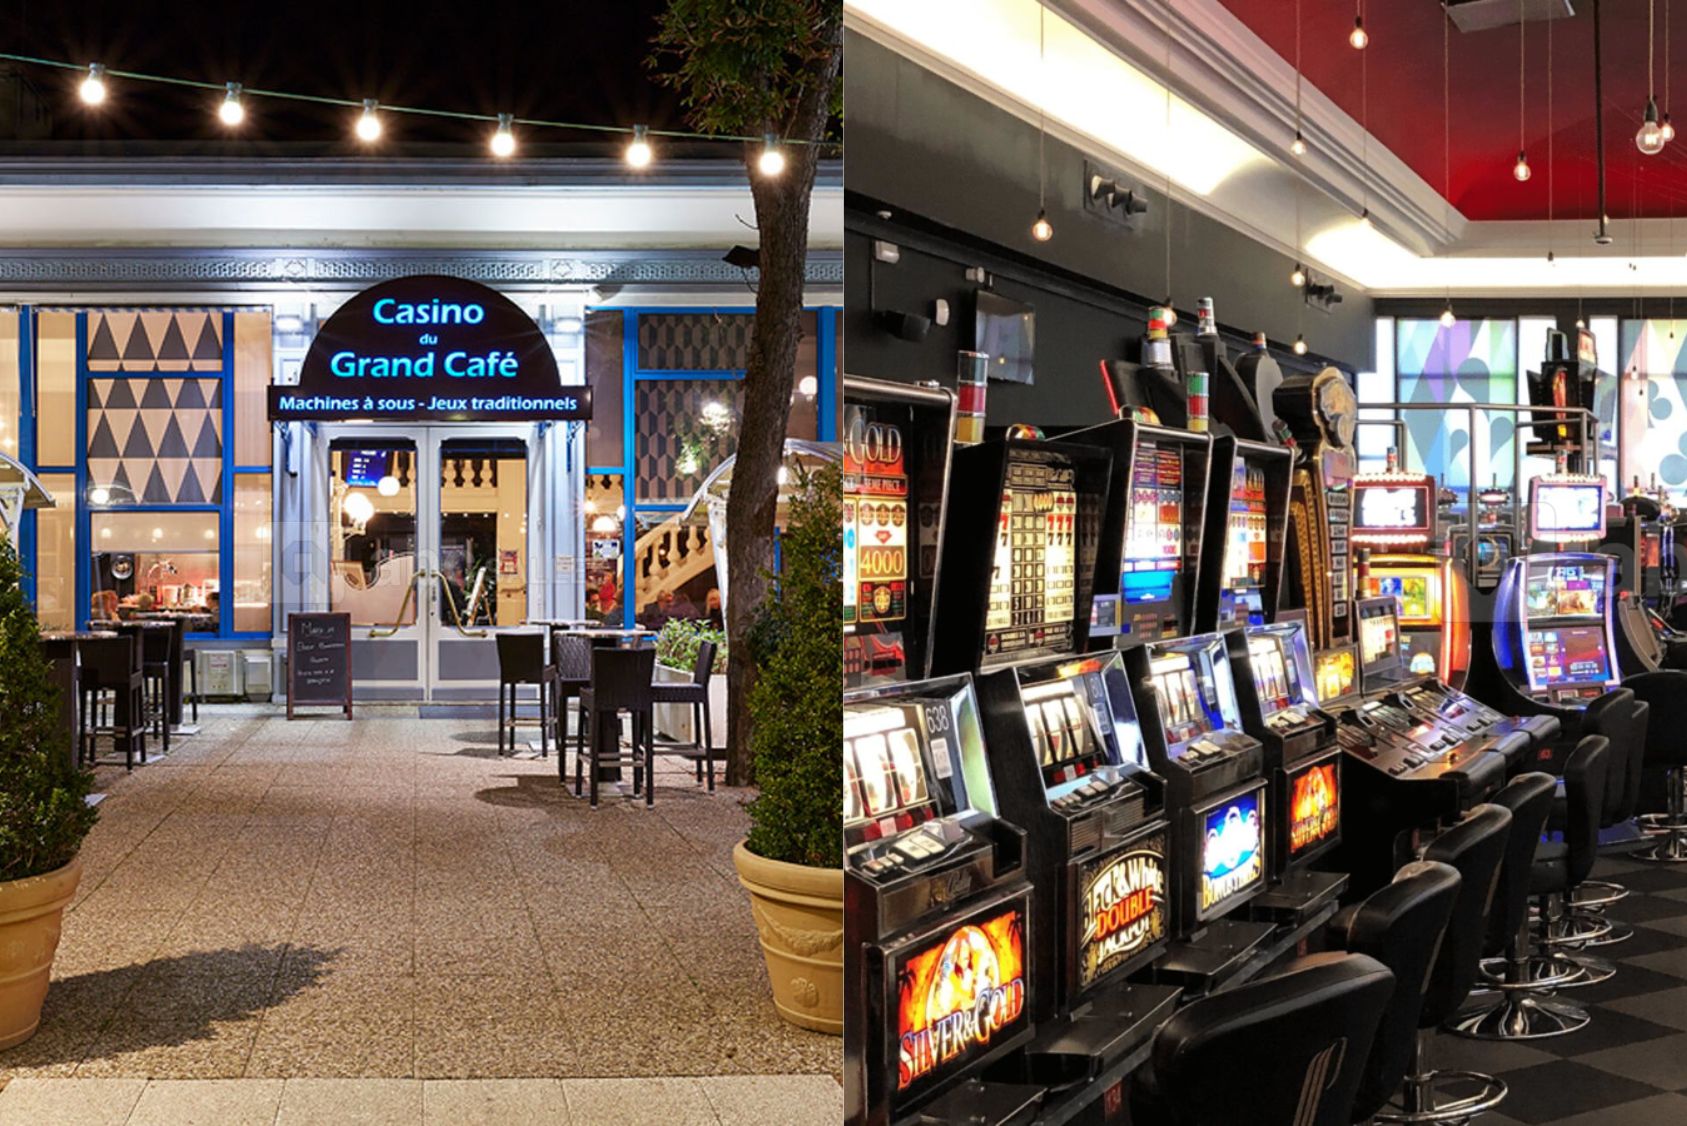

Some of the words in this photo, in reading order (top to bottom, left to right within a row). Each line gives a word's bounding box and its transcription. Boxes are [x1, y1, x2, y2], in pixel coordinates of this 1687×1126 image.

[373, 299, 484, 324] Casino
[419, 334, 438, 346] du
[331, 352, 434, 378] Grand
[444, 351, 519, 378] Café
[279, 396, 359, 411] Machines
[363, 396, 374, 411] à
[377, 399, 416, 411] sous
[427, 396, 468, 411] Jeux
[471, 396, 577, 411] traditionnels
[859, 549, 903, 575] 4000
[925, 704, 949, 734] 638
[1096, 886, 1154, 939] DOUBLE
